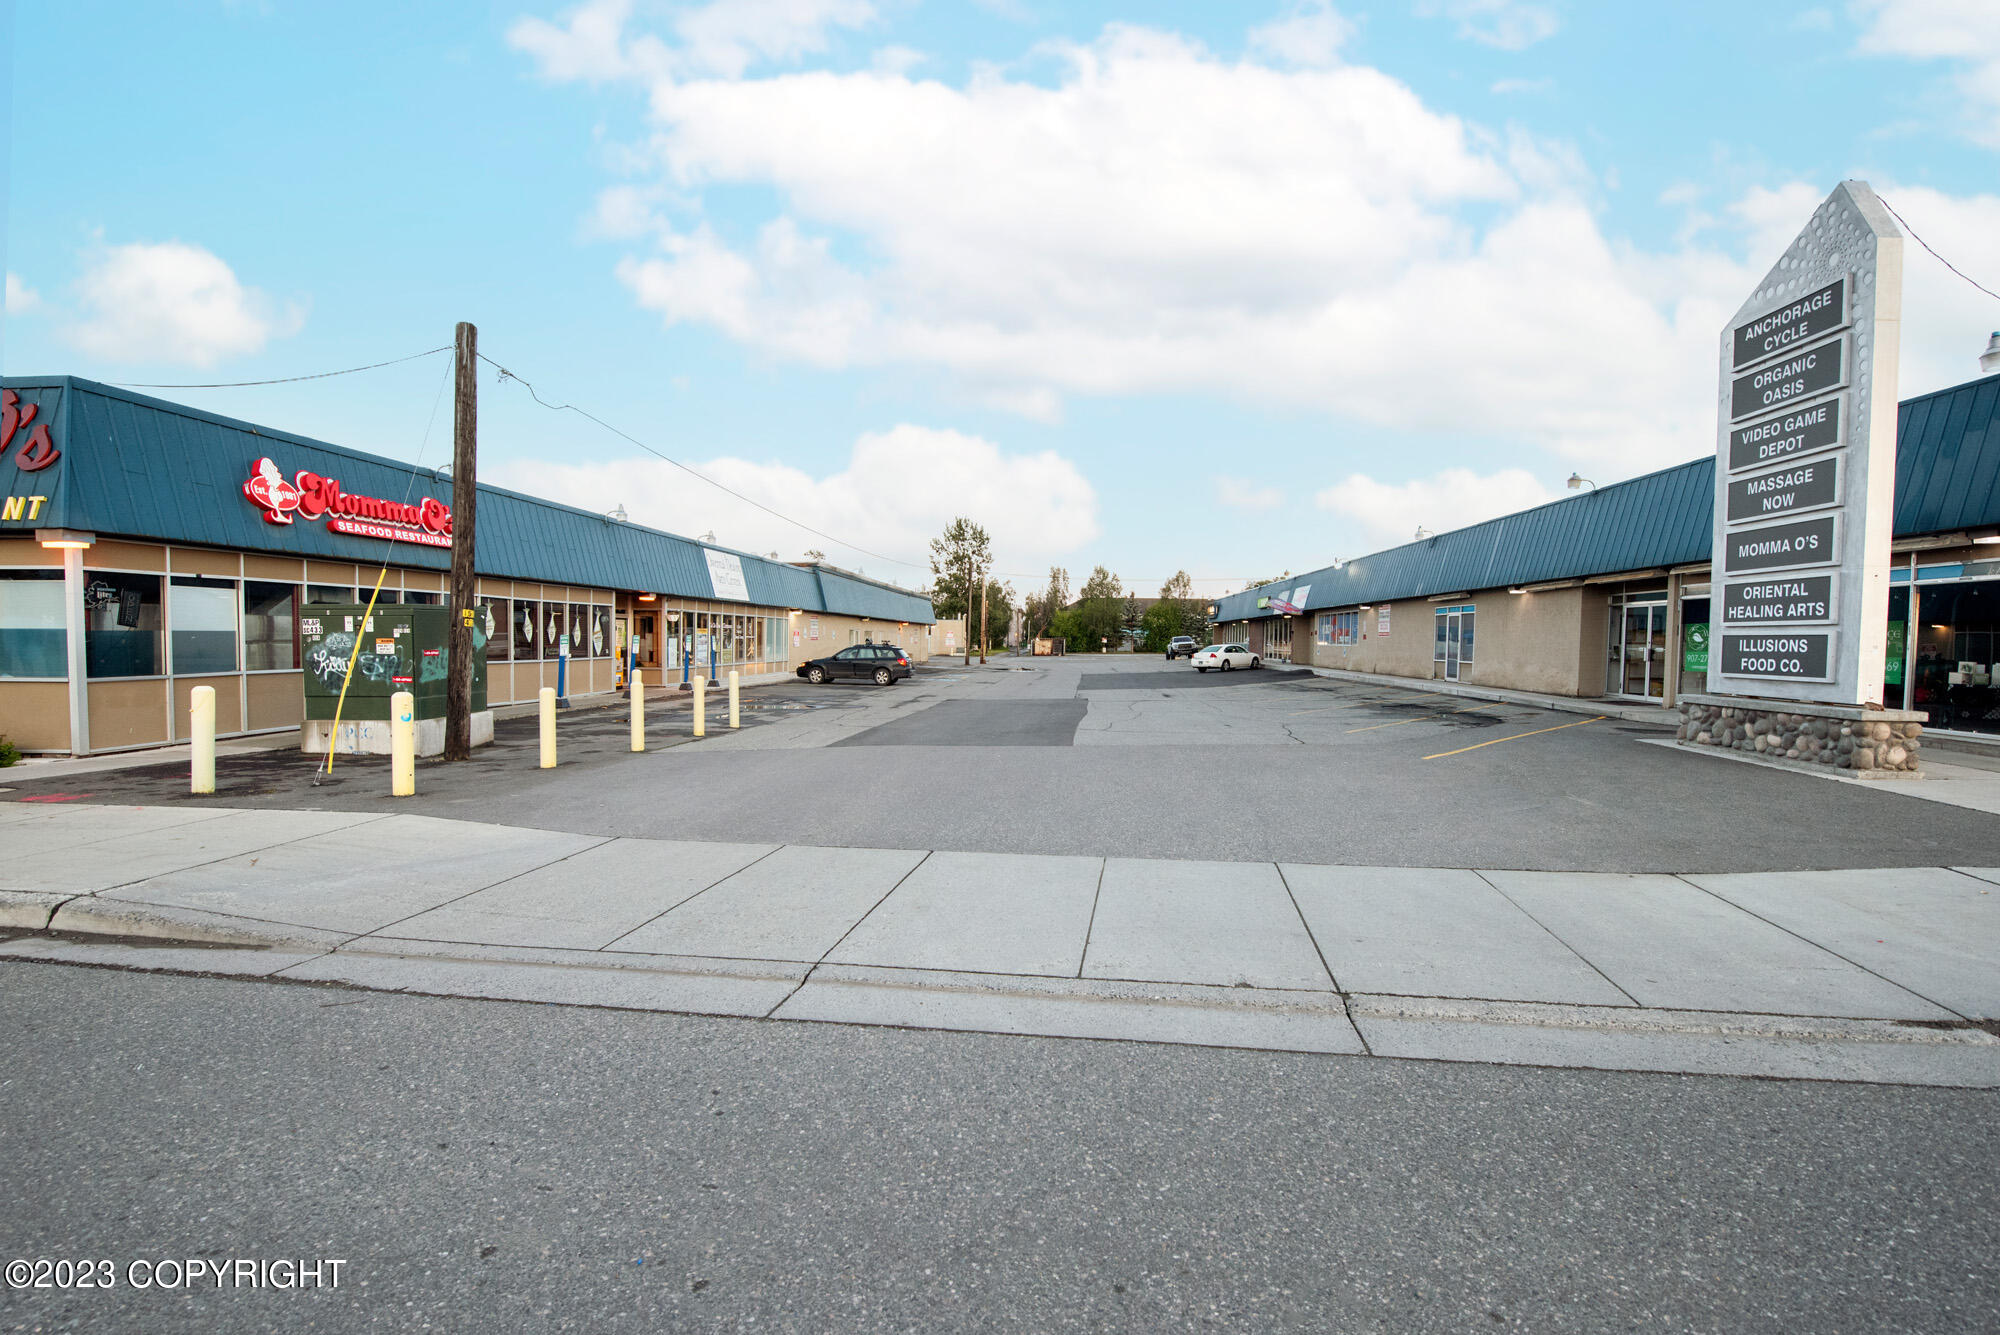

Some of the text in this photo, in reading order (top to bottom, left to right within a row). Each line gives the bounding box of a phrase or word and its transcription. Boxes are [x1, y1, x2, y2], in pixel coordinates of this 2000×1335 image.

[1745, 290, 1832, 341] ANCHORAGE
[1764, 321, 1808, 351] CYCLE
[1753, 354, 1816, 389] ORGANIC
[1763, 379, 1804, 404] OASIS
[1741, 407, 1827, 444] VIDEO GAME
[1759, 434, 1805, 459] DEPOT
[1747, 468, 1814, 495] MASSAGE
[298, 471, 423, 526] Momma
[1762, 492, 1795, 511] NOW
[338, 520, 453, 548] SEAFOOD RESTAURAN
[1738, 534, 1819, 558] MOMMA O'S
[1743, 583, 1809, 600] ORIENTAL
[1728, 602, 1825, 619] HEALING ARTS
[1739, 639, 1809, 653] ILLUSIONS
[1740, 657, 1804, 673] FOOD CO.
